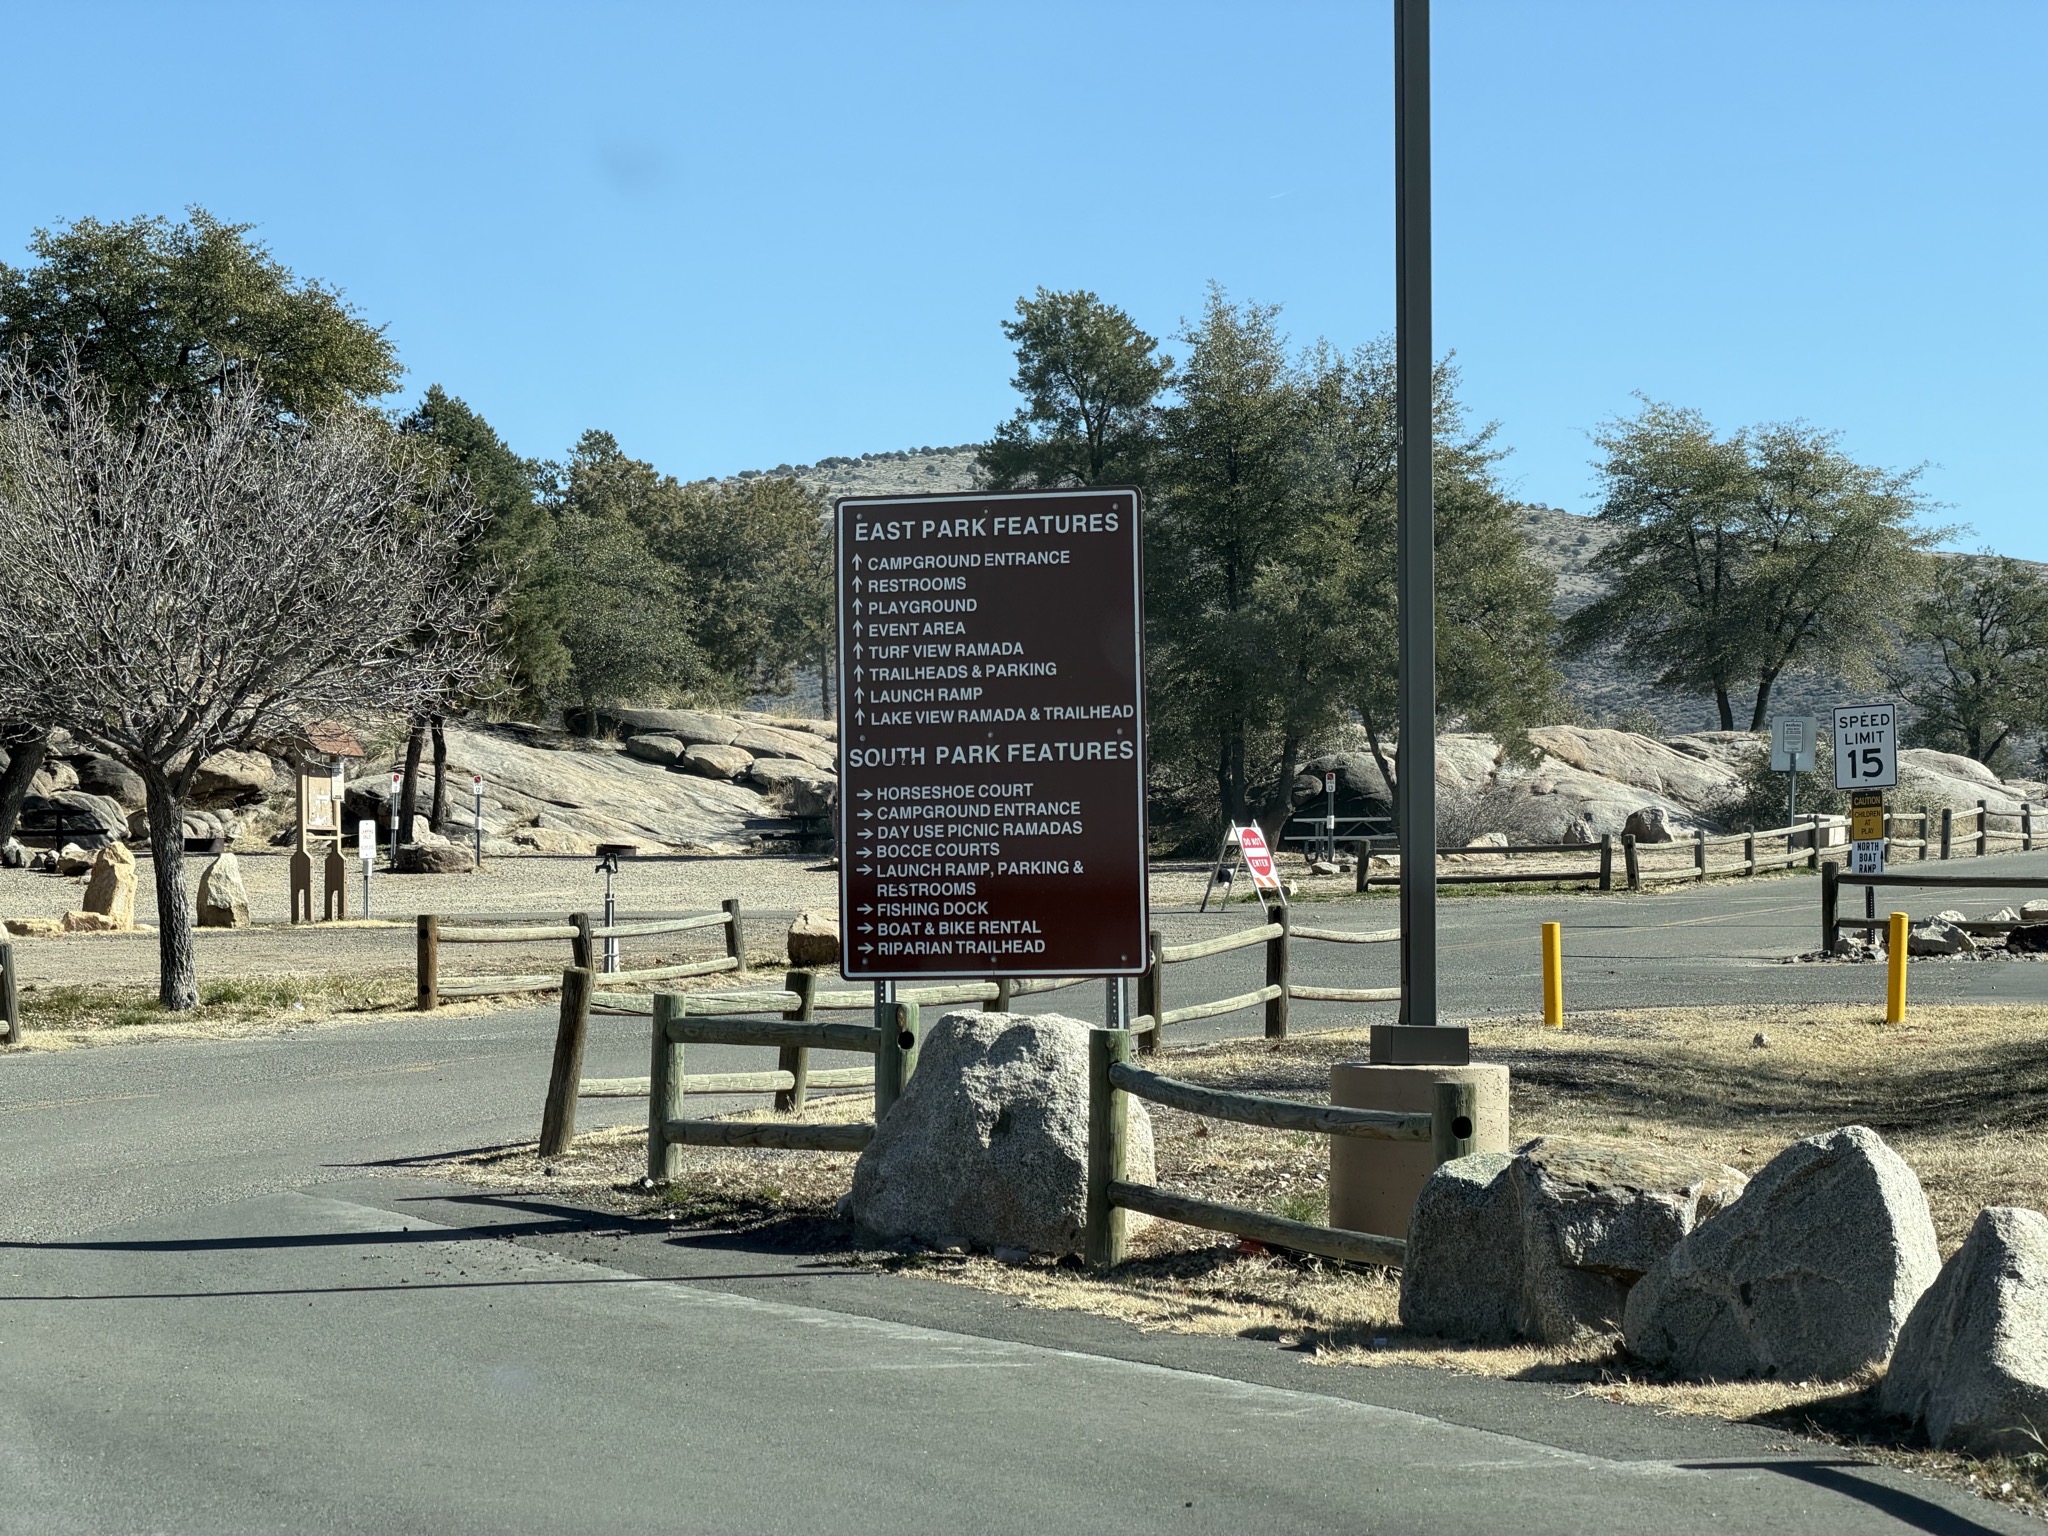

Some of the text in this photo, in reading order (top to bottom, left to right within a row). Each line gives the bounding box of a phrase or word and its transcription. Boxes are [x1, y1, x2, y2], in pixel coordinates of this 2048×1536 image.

[855, 513, 1119, 541] EAST PARK FEATURES
[868, 550, 1070, 571] CAMPGROUND ENTRANCE
[868, 576, 966, 592] RESTROOMS
[868, 598, 977, 614] PLAYGROUND
[869, 622, 966, 637] EVENT AREA
[869, 642, 1024, 659] TURF VIEW RAMADA
[870, 662, 1057, 681] TRAILHEADS & PARKING
[870, 688, 982, 704] LAUNCH RAMP
[871, 704, 1134, 726] LAKE VIEW RAMADA & TRAILHEAD
[1839, 714, 1890, 728] SPEED
[1845, 731, 1884, 745] LIMIT
[850, 740, 1134, 768] SOUTH PARK FEATURES
[1848, 748, 1883, 778] 15
[877, 783, 1033, 800] HORSESHOE COURT
[1854, 796, 1880, 805] CAUTION
[877, 802, 1080, 820] CAMPGROUND ENTRANCE
[878, 821, 1083, 839] DAY USE PICNIC RAMADAS
[877, 843, 1000, 858] BOCCE COURTS
[1857, 842, 1879, 851] NORTH
[1252, 859, 1269, 868] ENTER
[1859, 853, 1876, 862] BOAT
[877, 861, 1084, 878] LAUNCH RAMP, PARKING &
[1859, 864, 1876, 873] RAMP
[877, 882, 976, 897] RESTROOMS
[878, 902, 988, 916] FISHING DOCK
[878, 920, 1041, 936] BOAT & BIKE RENTAL
[878, 940, 1045, 955] RIPARIAN TRAILHEAD
